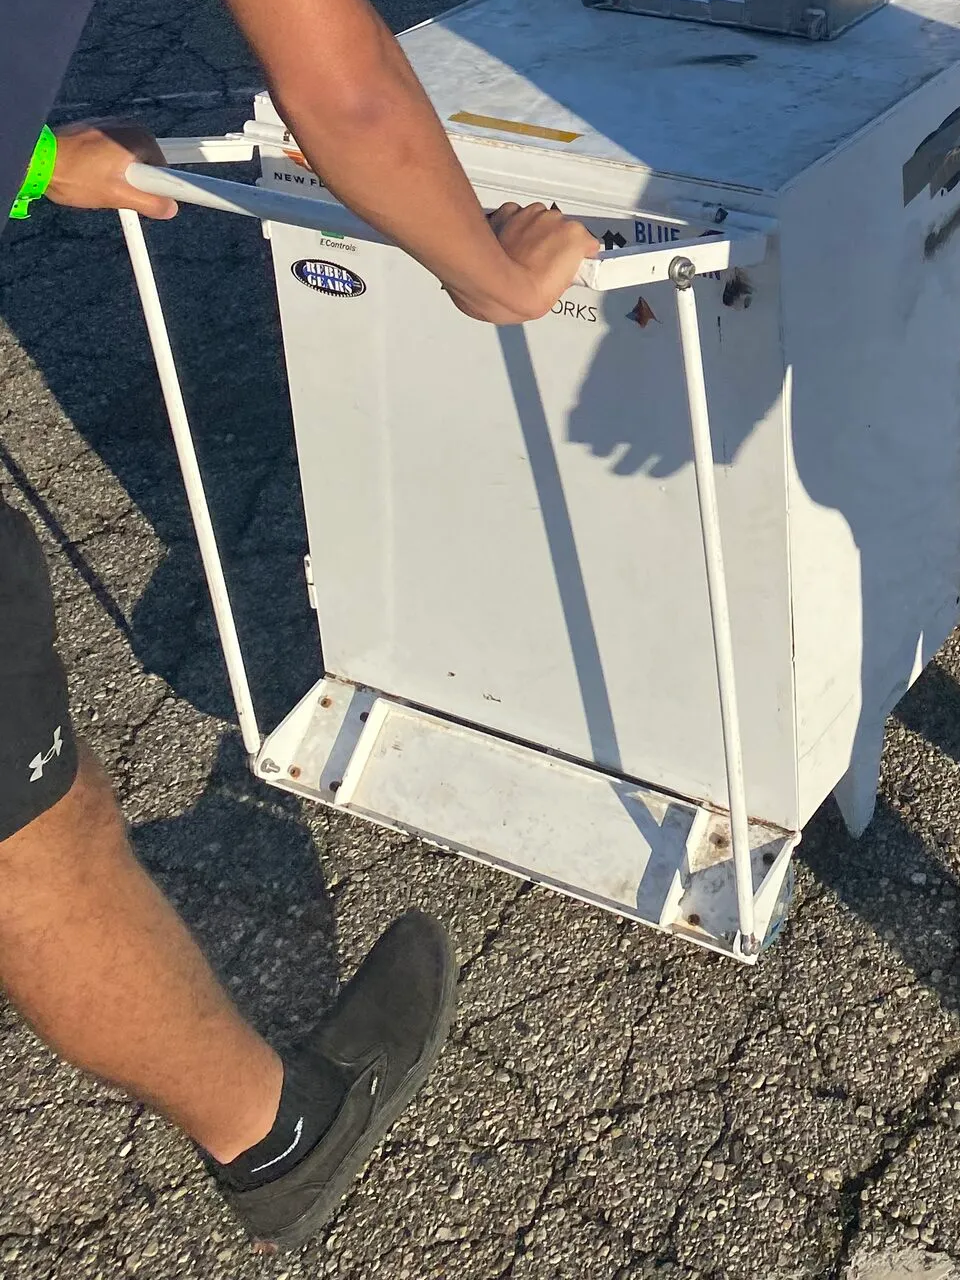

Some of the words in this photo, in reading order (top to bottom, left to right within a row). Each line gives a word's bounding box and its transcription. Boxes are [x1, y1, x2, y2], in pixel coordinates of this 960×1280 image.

[273, 172, 305, 186] NEW
[310, 178, 325, 188] FL
[634, 220, 681, 245] BLUE
[305, 261, 352, 281] REBEL
[306, 275, 353, 294] GEARS
[550, 299, 598, 323] ORKS
